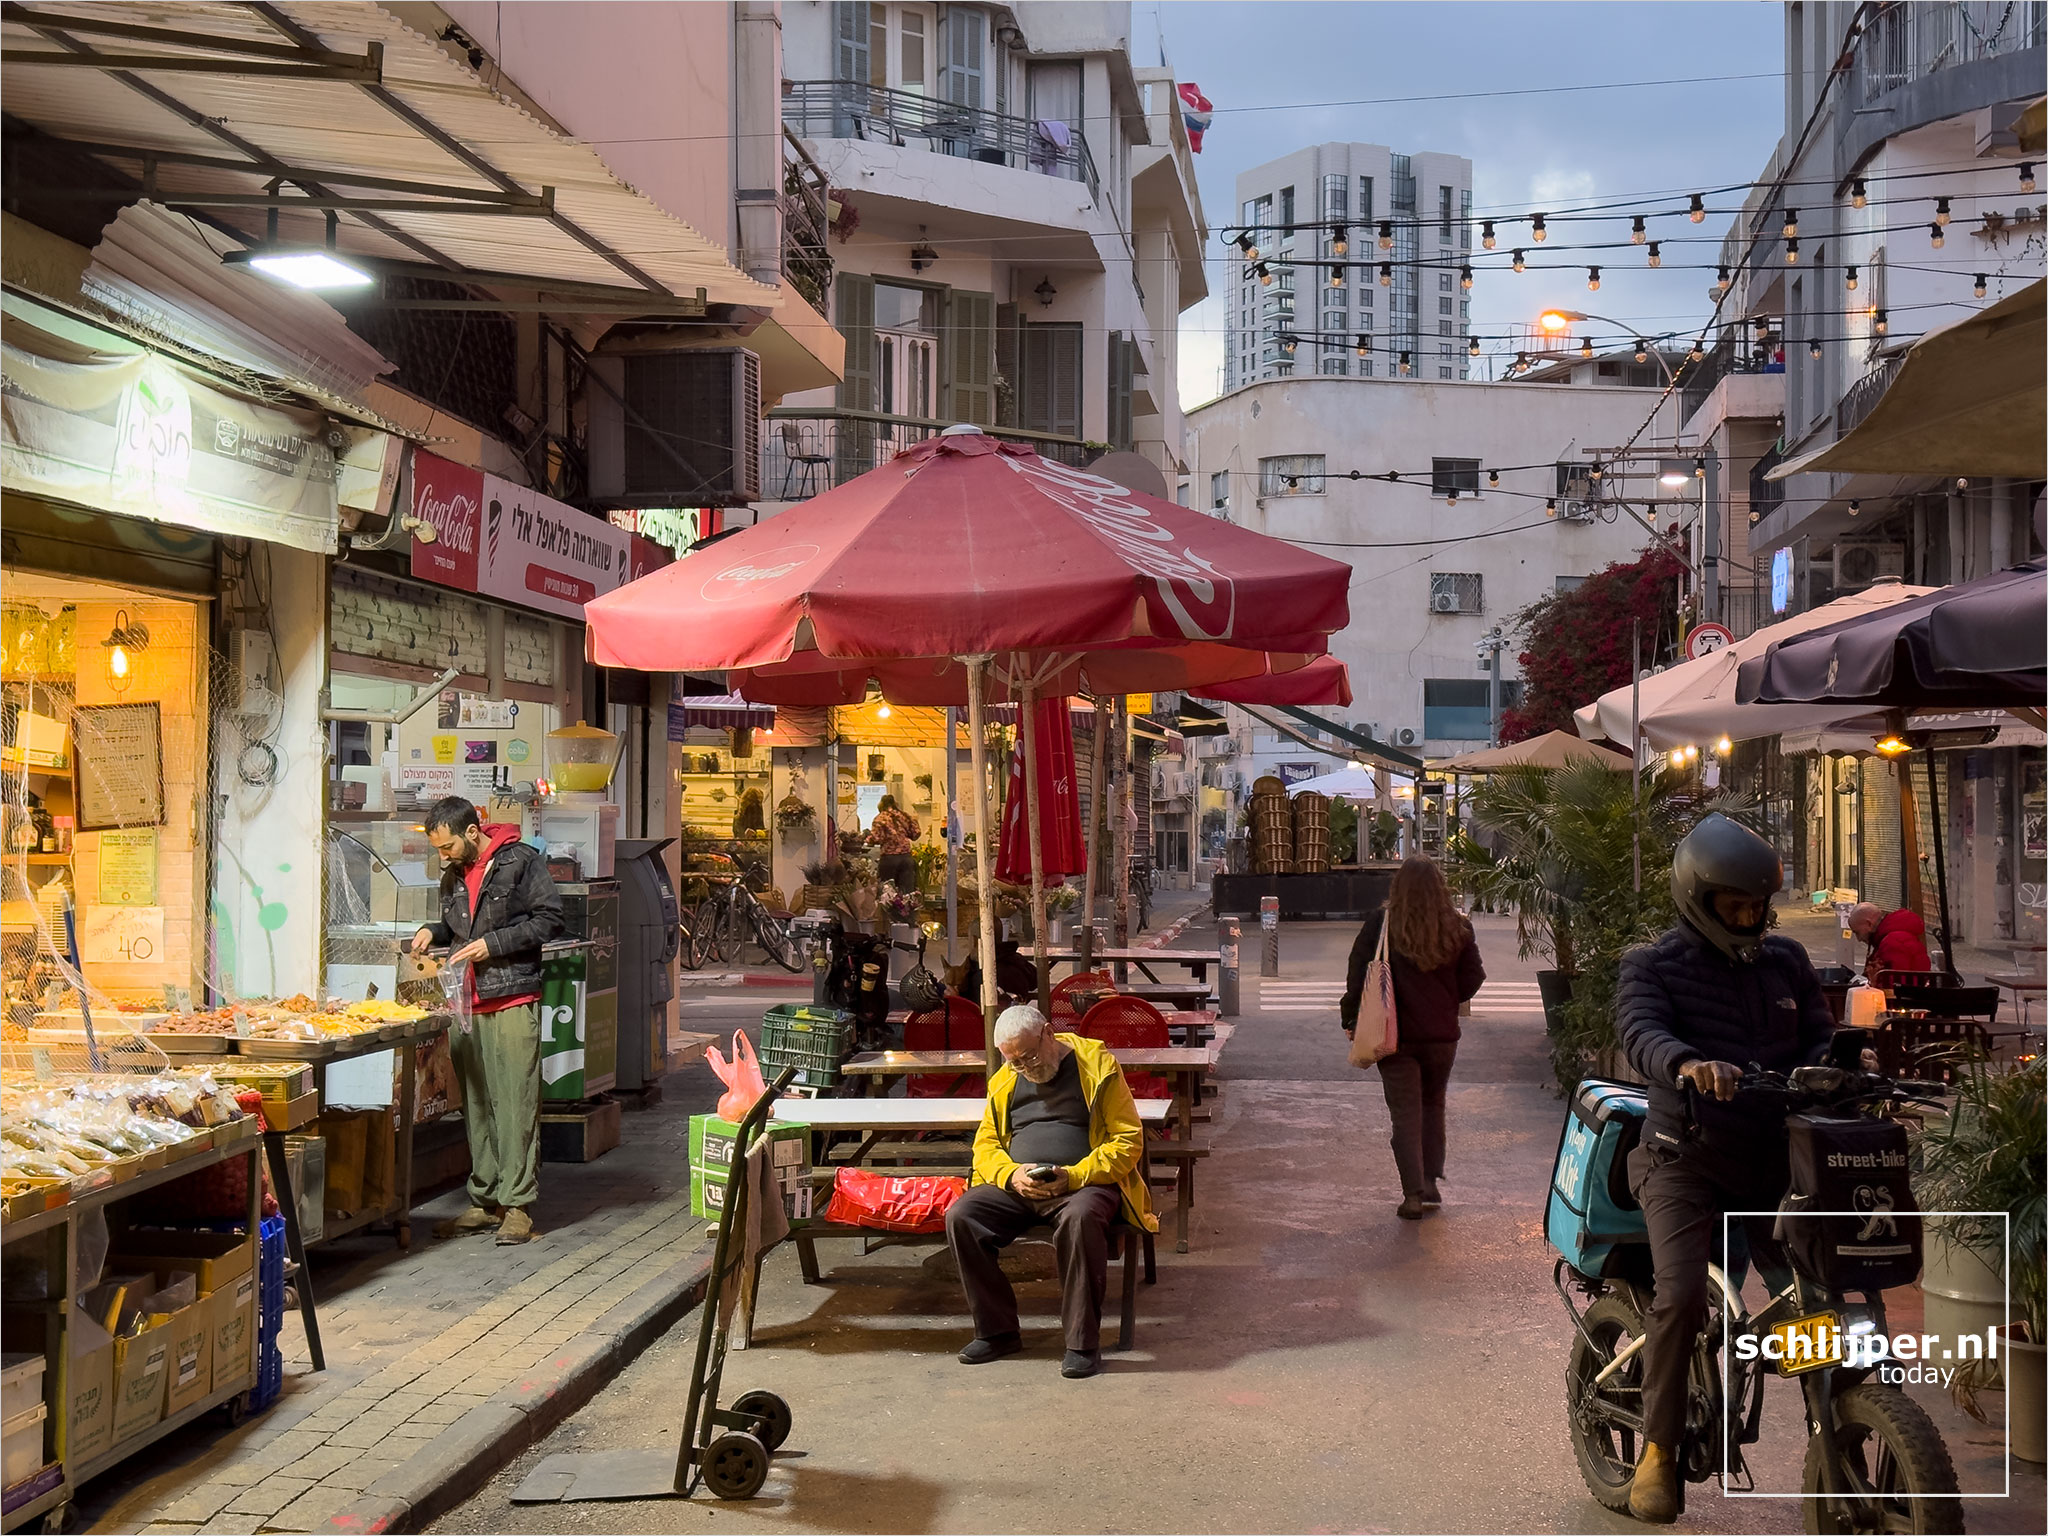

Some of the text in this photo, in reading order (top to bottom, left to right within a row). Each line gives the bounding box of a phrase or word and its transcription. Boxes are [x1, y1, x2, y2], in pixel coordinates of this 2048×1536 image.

[417, 484, 478, 555] Coca-Cola
[512, 503, 534, 545] אלי
[536, 510, 571, 557] פלאפל
[572, 530, 612, 572] שווארמה
[403, 768, 454, 780] המקום מצולם
[118, 935, 154, 961] 40
[1827, 1149, 1906, 1168] street-bike
